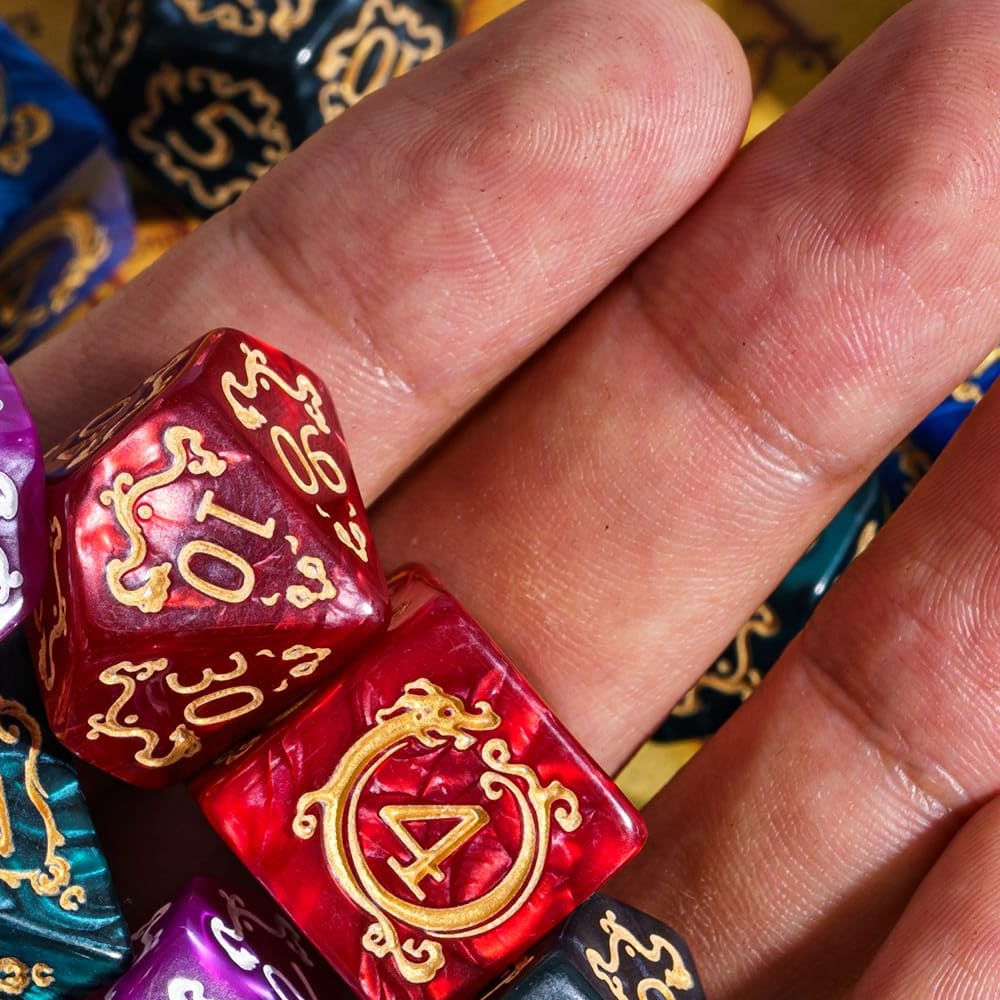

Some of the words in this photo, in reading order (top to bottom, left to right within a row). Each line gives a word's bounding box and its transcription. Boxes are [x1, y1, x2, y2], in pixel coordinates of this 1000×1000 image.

[178, 491, 275, 603] 10
[166, 652, 264, 726] 30
[379, 804, 490, 901] 4
